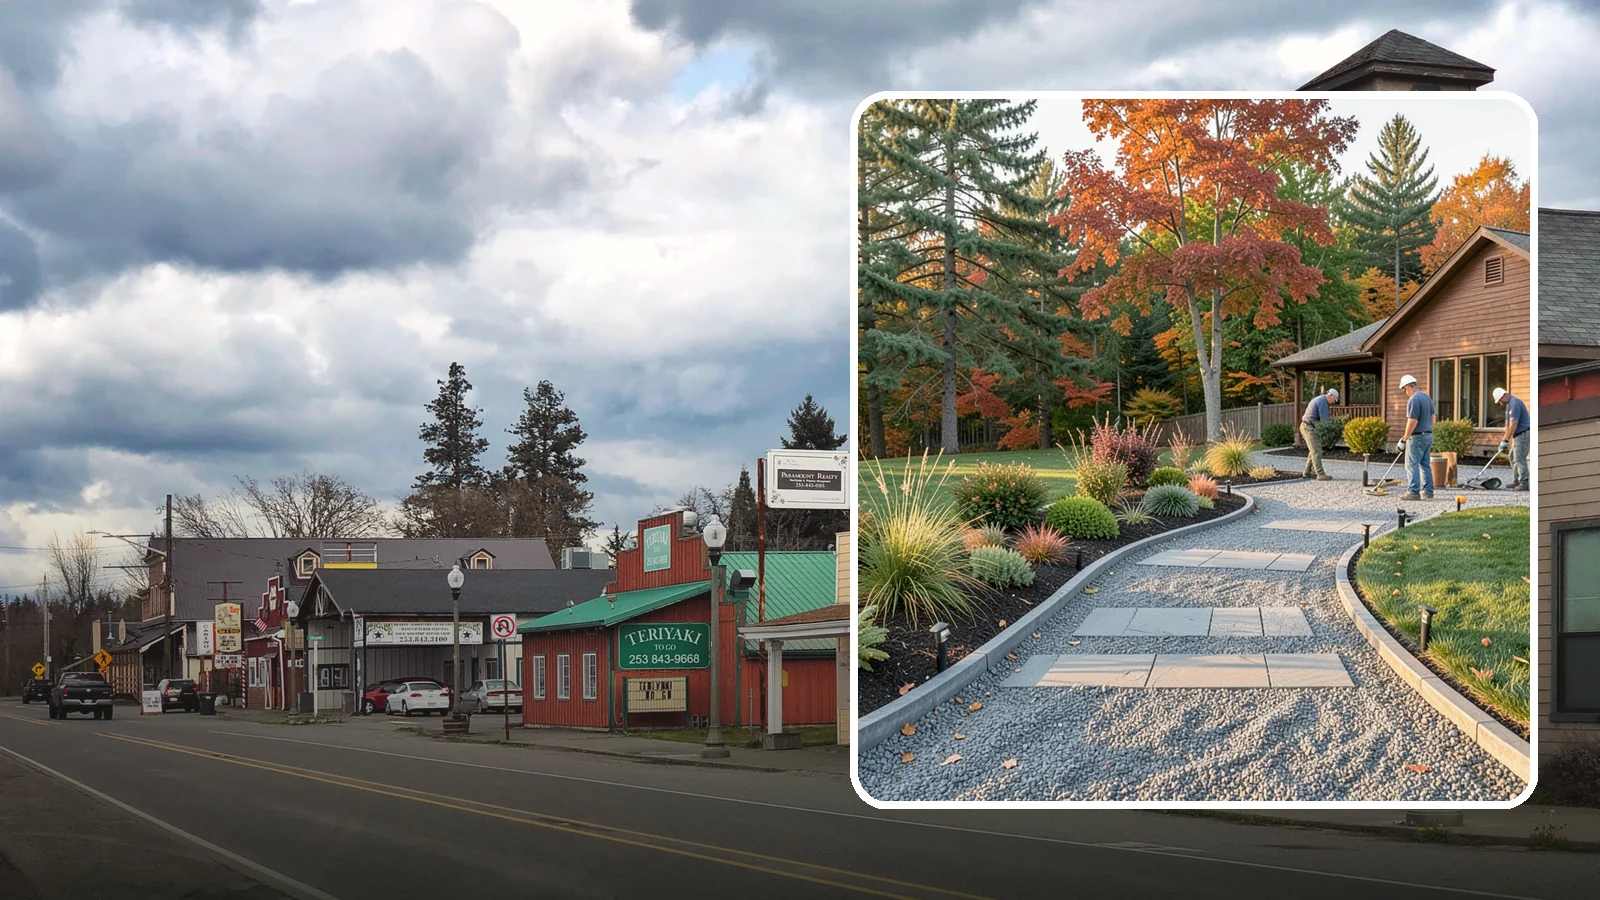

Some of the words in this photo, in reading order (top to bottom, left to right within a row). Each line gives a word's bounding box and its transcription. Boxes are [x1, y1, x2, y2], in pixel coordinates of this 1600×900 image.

[817, 472, 838, 480] REALTY
[624, 627, 702, 646] TERIYAKI
[654, 643, 665, 651] TO
[665, 643, 677, 651] GO
[628, 654, 649, 665] 253
[651, 653, 700, 664] 843-9668
